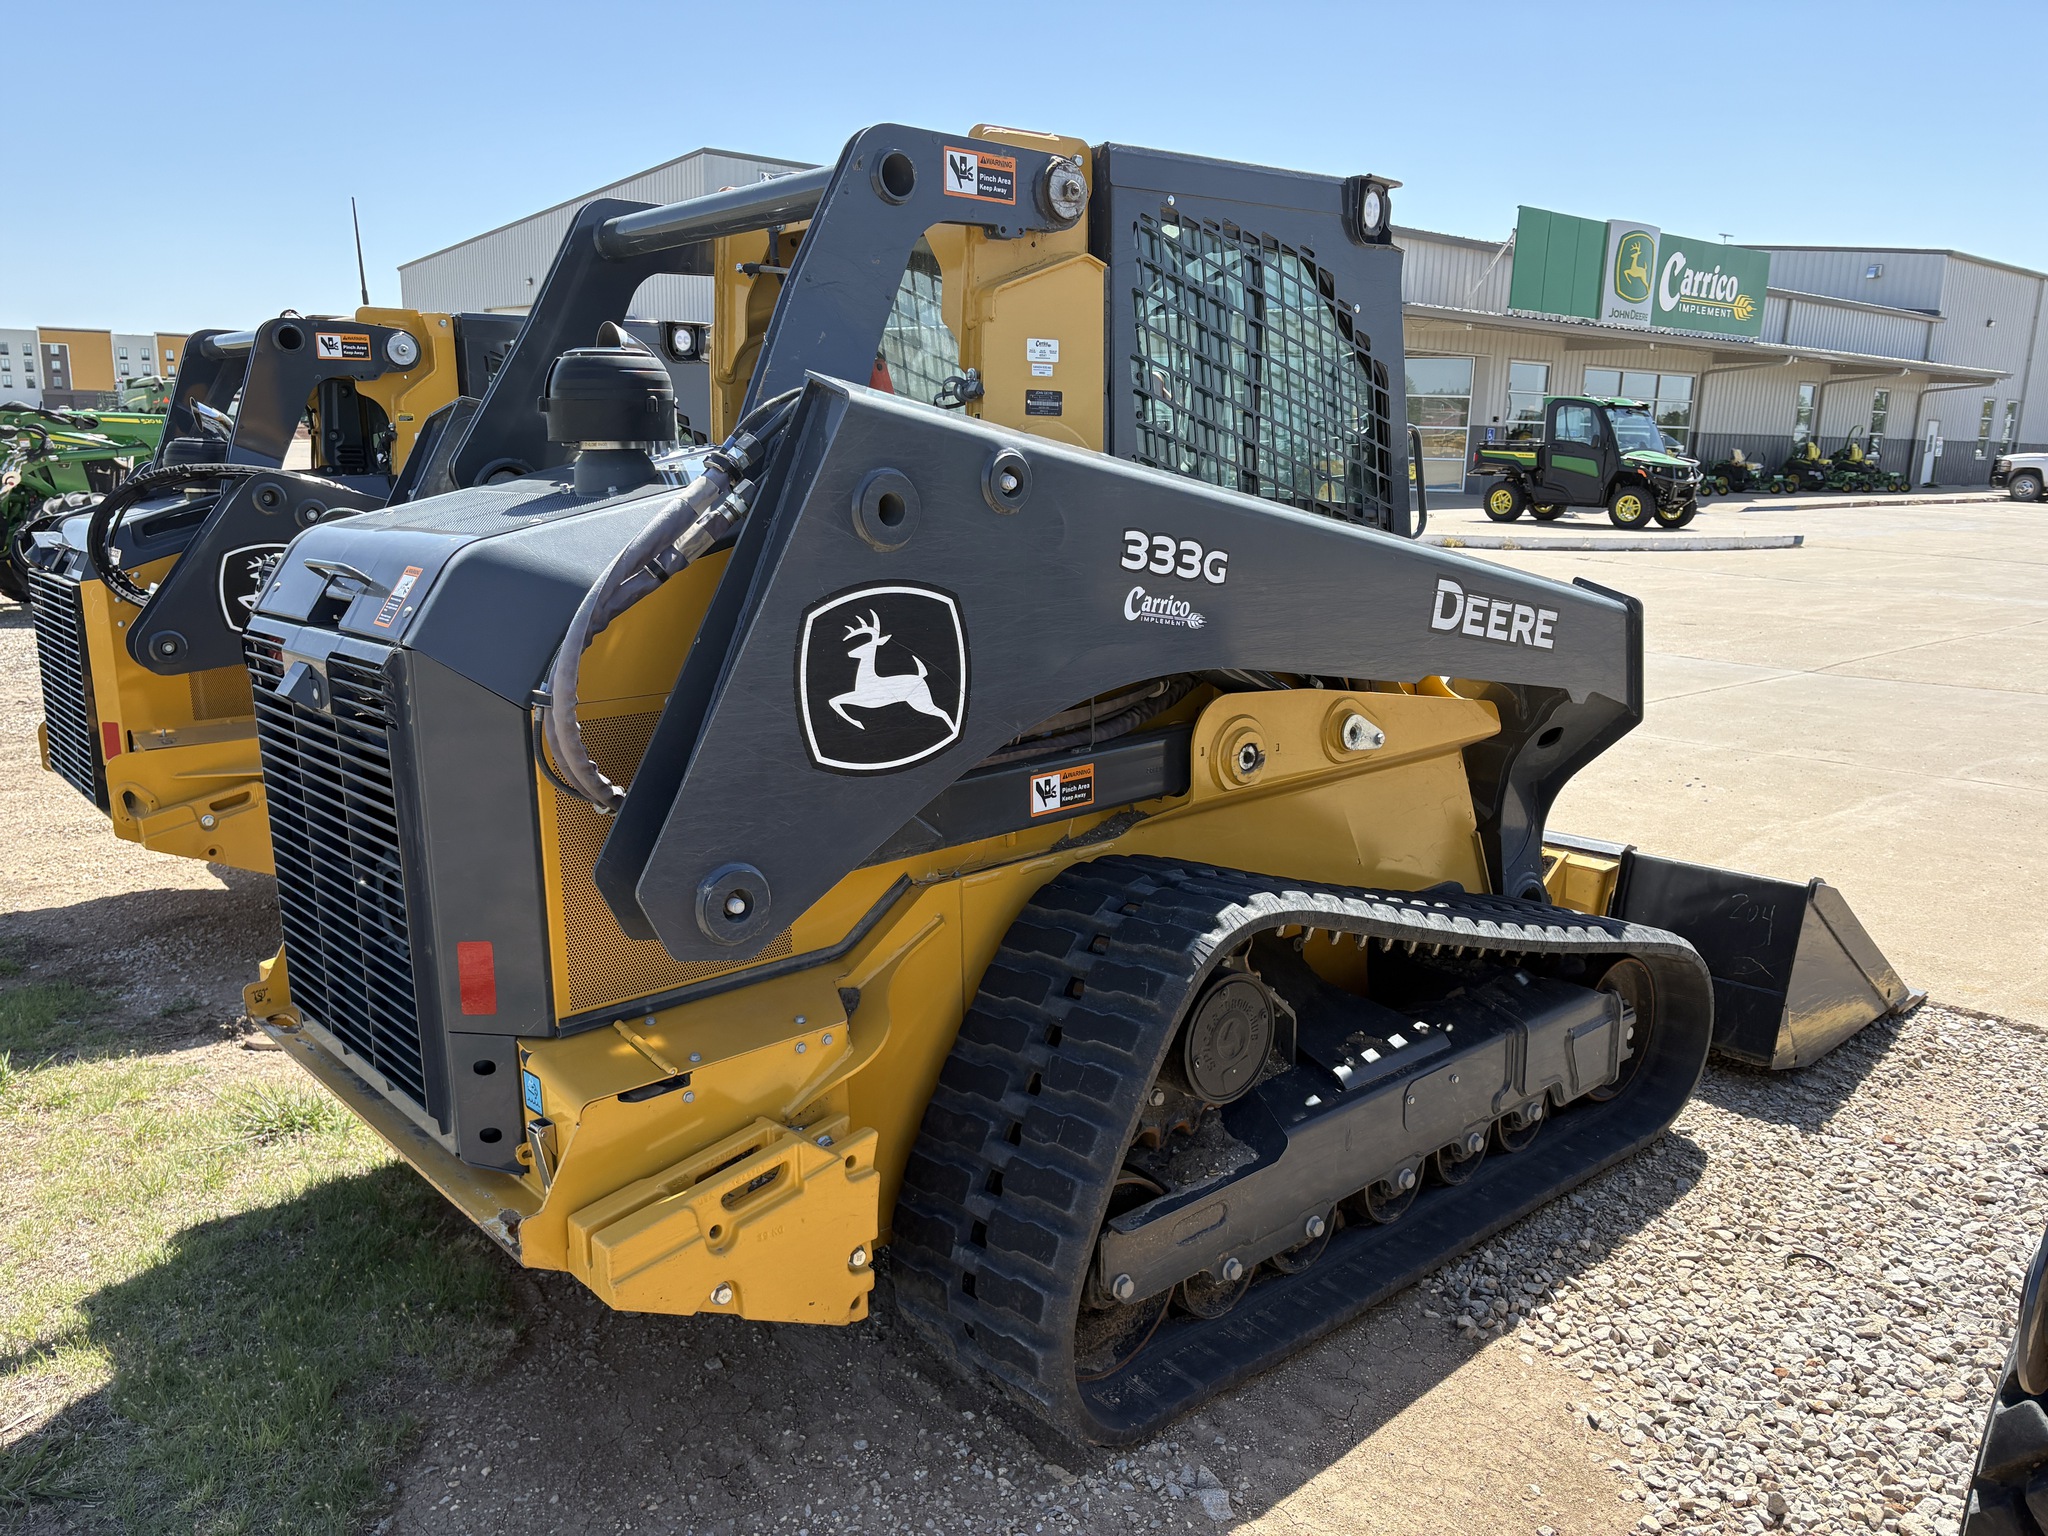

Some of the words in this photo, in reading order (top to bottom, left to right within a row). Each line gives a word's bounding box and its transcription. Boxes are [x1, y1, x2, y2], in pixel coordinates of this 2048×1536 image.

[986, 157, 1012, 168] WARNING
[980, 173, 997, 182] Pinch
[998, 176, 1011, 185] Area
[980, 184, 993, 192] Keep
[993, 186, 1007, 194] Away
[1659, 251, 1738, 312] Carrico
[1608, 308, 1631, 320] JOHN
[1630, 308, 1648, 322] DEERE
[1678, 302, 1732, 318] IMPLEMENT
[1121, 530, 1228, 584] 333G
[1124, 586, 1190, 622] Carrico
[1140, 615, 1186, 628] IMPLEMENT
[1431, 579, 1558, 650] DEERE
[1068, 769, 1091, 778] WARNING
[1062, 786, 1077, 794] Pinch
[1203, 1014, 1218, 1071] SPICER
